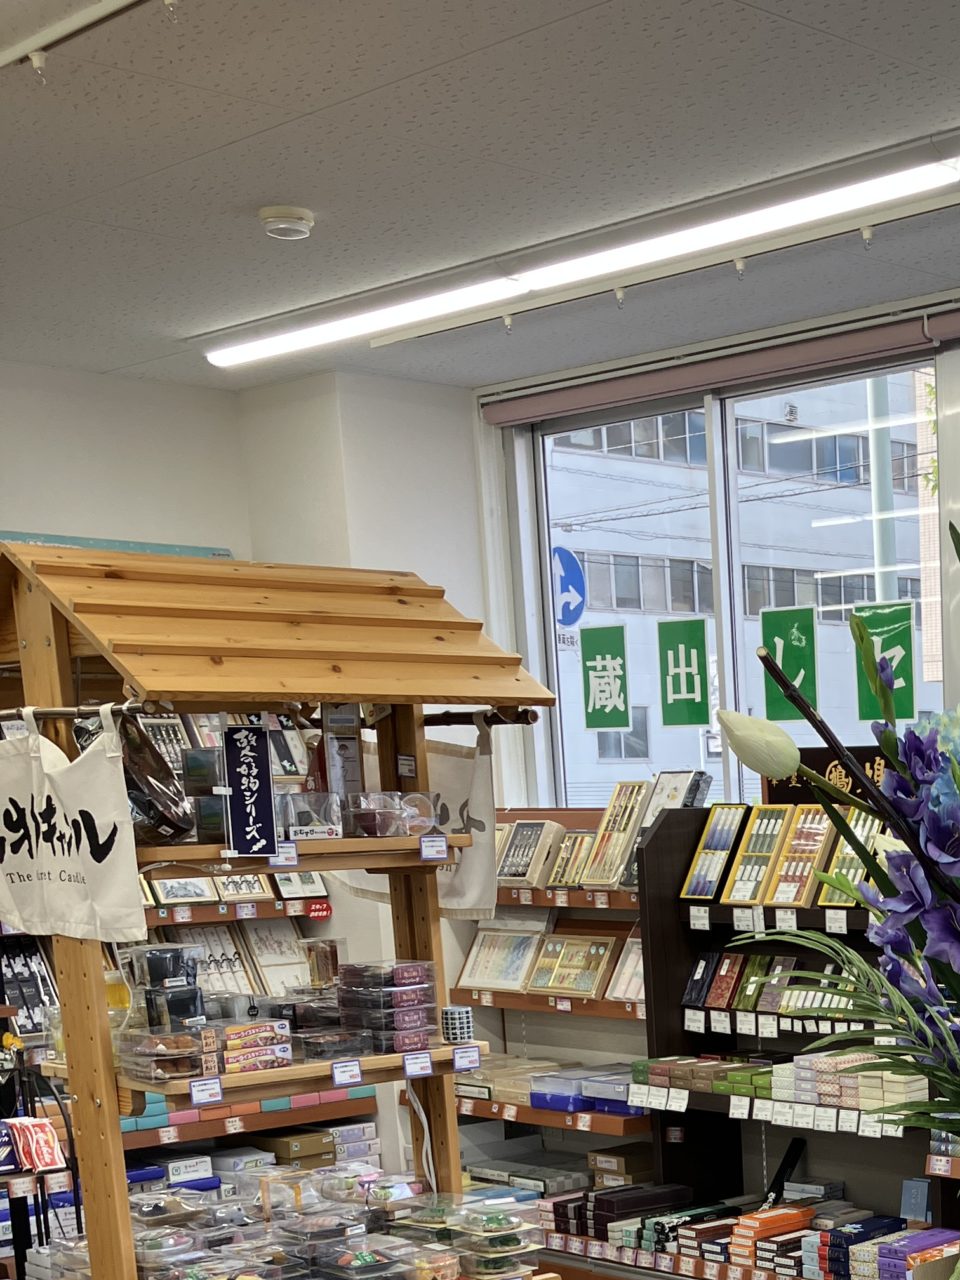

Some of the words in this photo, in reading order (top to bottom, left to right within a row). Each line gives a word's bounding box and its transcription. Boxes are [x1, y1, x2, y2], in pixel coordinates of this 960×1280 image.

[586, 654, 626, 713] 蔵
[666, 644, 702, 704] 出
[774, 636, 807, 691] し
[233, 729, 262, 840] 故人の好物シリーズ
[6, 871, 33, 884] The
